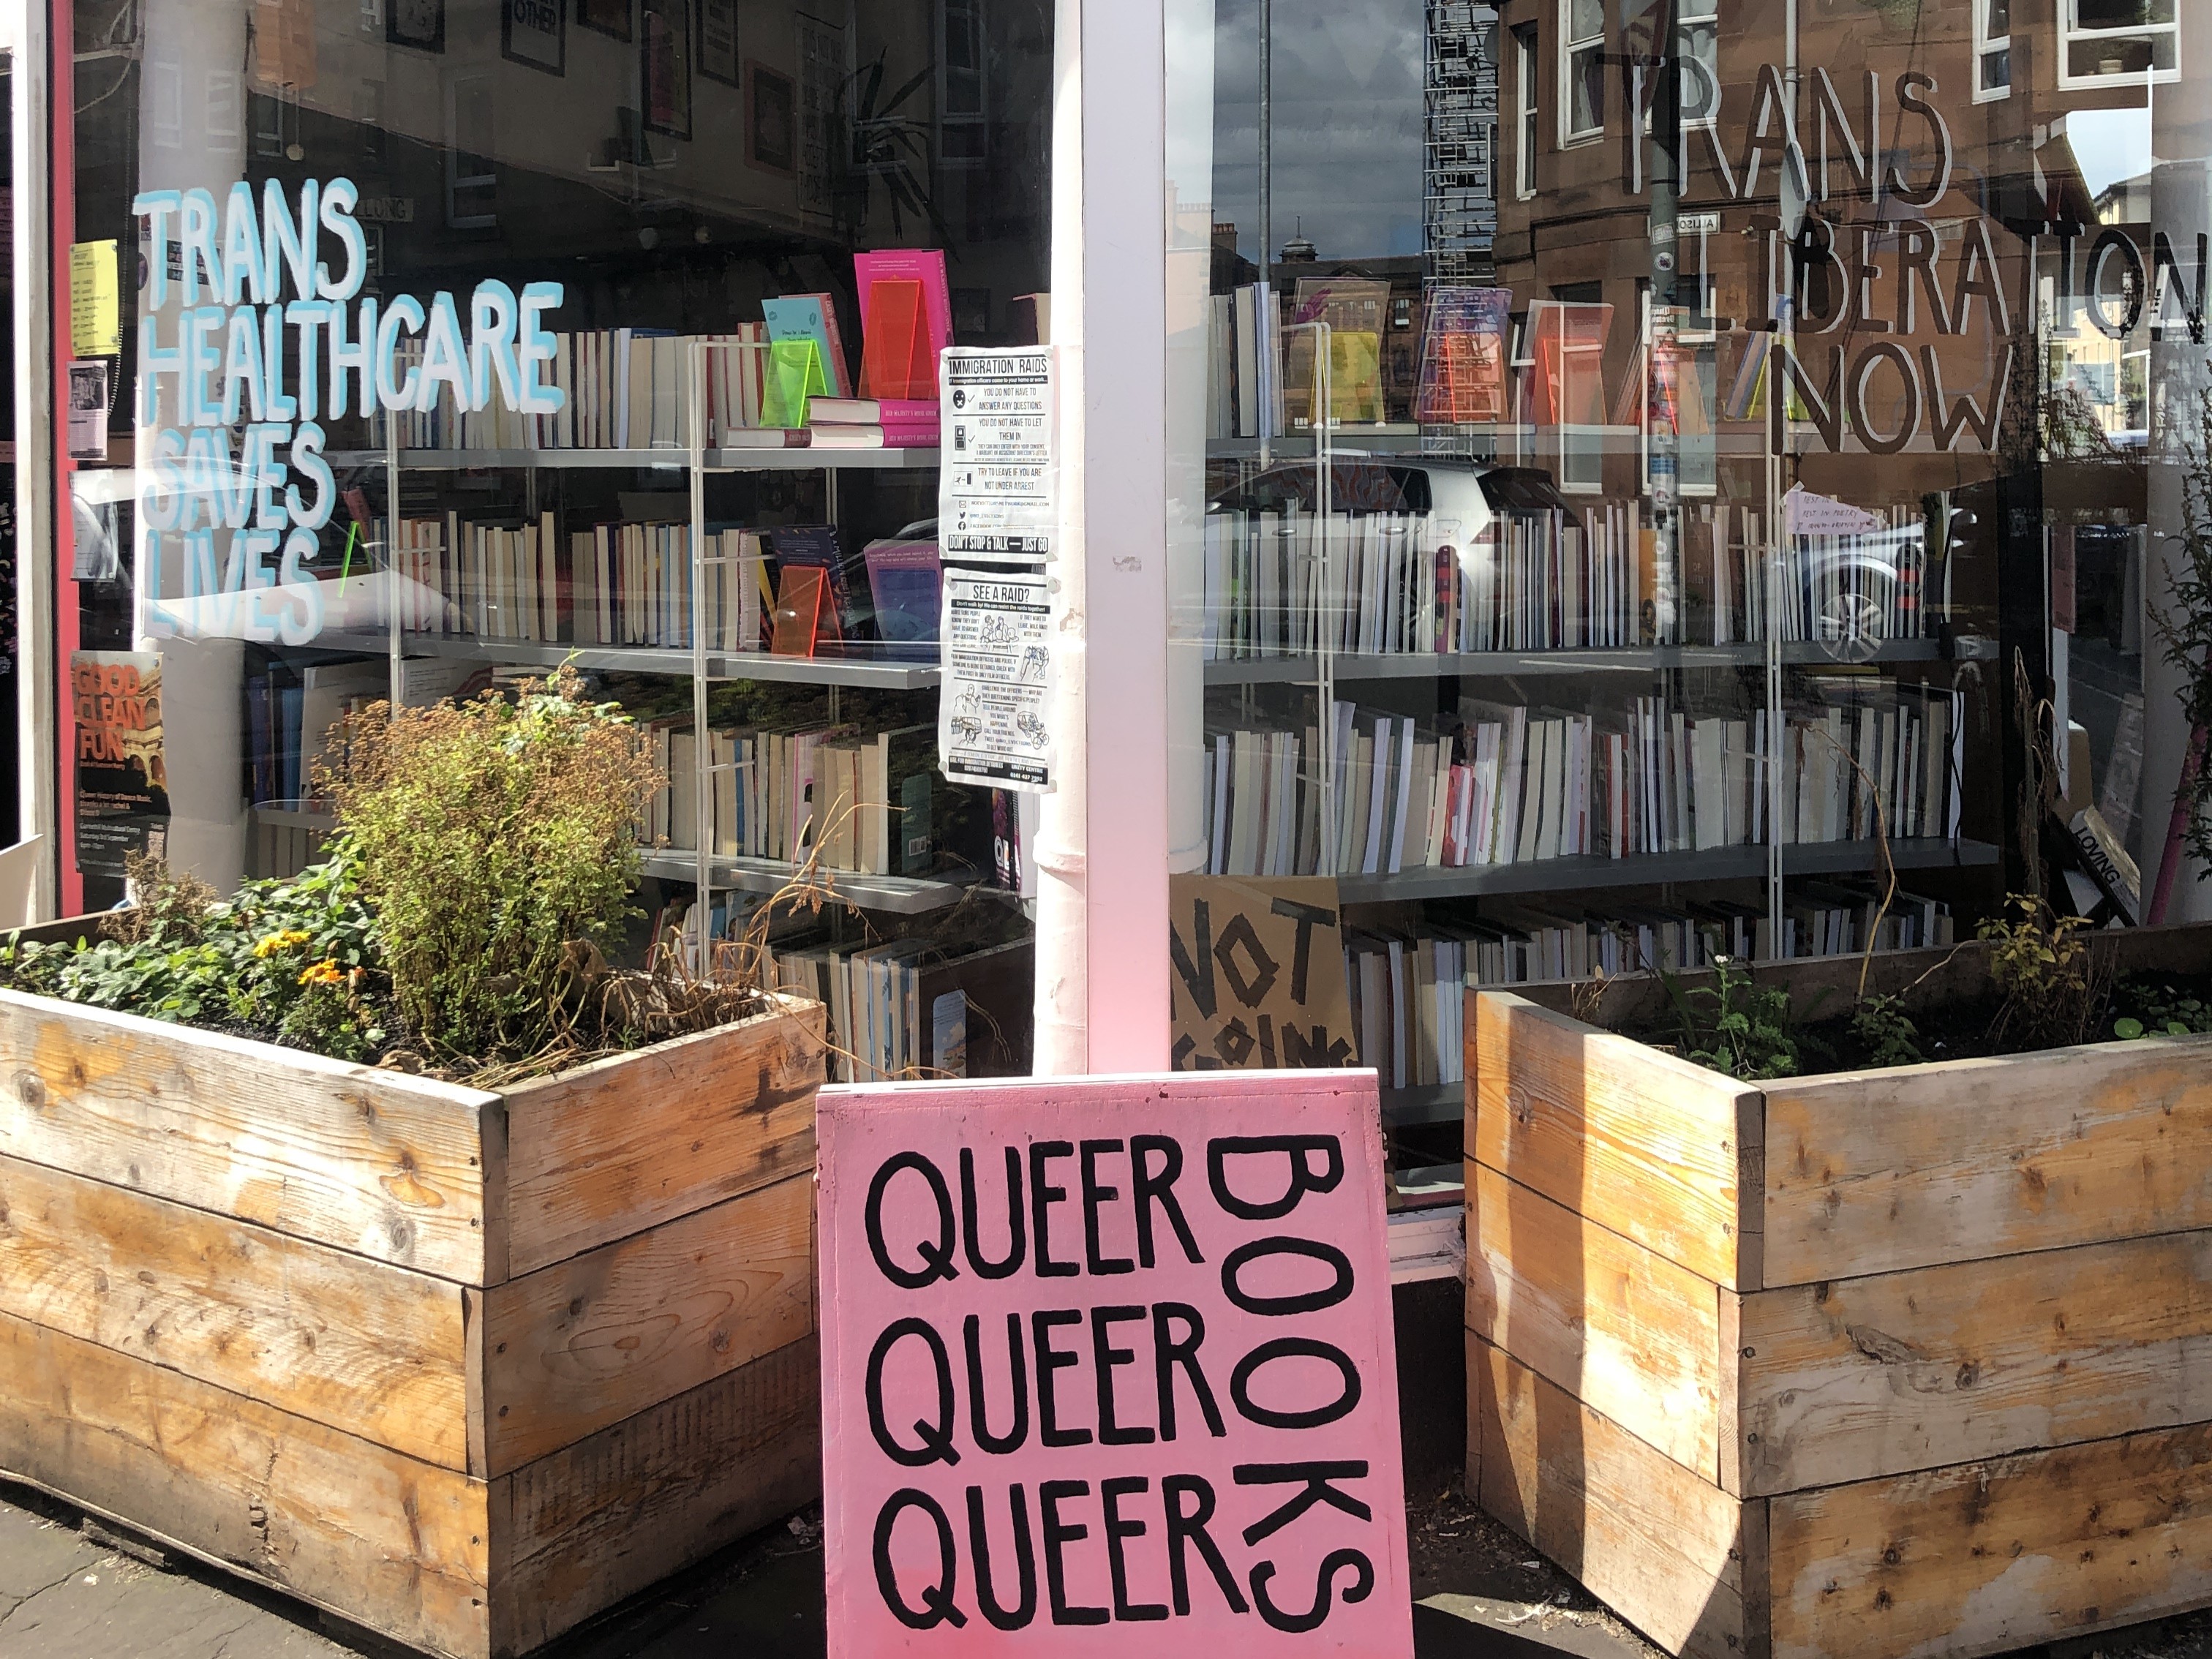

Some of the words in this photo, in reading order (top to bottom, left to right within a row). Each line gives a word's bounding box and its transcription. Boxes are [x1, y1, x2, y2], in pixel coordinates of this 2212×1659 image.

[1595, 53, 1952, 208] TRANS
[132, 177, 367, 312] TRANS
[1689, 214, 2208, 345] LIBERATION
[138, 279, 565, 427] HEALTHCARE
[949, 359, 1013, 375] IMMIGRATION
[1020, 358, 1047, 373] RAIDS
[979, 402, 1001, 410] ANSWER
[1002, 402, 1012, 410] ANY
[1014, 402, 1042, 410] QUESTIONS
[1004, 388, 1014, 396] NOT
[1015, 388, 1028, 396] HAVE
[1770, 343, 2013, 455] NOW
[979, 418, 988, 426] YOU
[990, 418, 996, 426] DO
[998, 418, 1008, 426] NOT
[1010, 418, 1023, 426] HAVE
[1025, 418, 1031, 426] TO
[1033, 418, 1042, 426] LET
[999, 432, 1014, 440] THEM
[1016, 432, 1021, 440] IN
[143, 421, 337, 533] SAVES
[978, 468, 987, 476] TRY
[989, 468, 995, 476] TO
[996, 468, 1012, 476] LEAVE
[1013, 468, 1017, 476] IF
[1019, 468, 1029, 476] YOU
[1031, 468, 1042, 476] ARE
[985, 481, 994, 489] NOT
[996, 481, 1012, 489] UNDER
[1014, 481, 1034, 490] ARREST
[833, 546, 846, 576] MILLION
[949, 535, 968, 549] DON'T
[969, 536, 985, 549] STOP
[987, 537, 991, 549] &
[993, 536, 1009, 550] TALK
[1022, 538, 1037, 551] JUST
[1038, 538, 1047, 552] GO
[143, 527, 326, 647] LIVES
[974, 585, 990, 599] SEE
[993, 587, 998, 601] A
[1001, 587, 1030, 602] RAID?
[75, 664, 140, 696] GOOD
[78, 697, 147, 731] CLEAN
[80, 729, 125, 761] FUN
[2074, 827, 2121, 884] LOVING
[1170, 897, 1336, 1020] NOT
[865, 1135, 1205, 1290] QUEER
[865, 1302, 1227, 1467] QUEER
[1207, 1134, 1375, 1633] BOOKS
[872, 1474, 1250, 1631] QUEER
